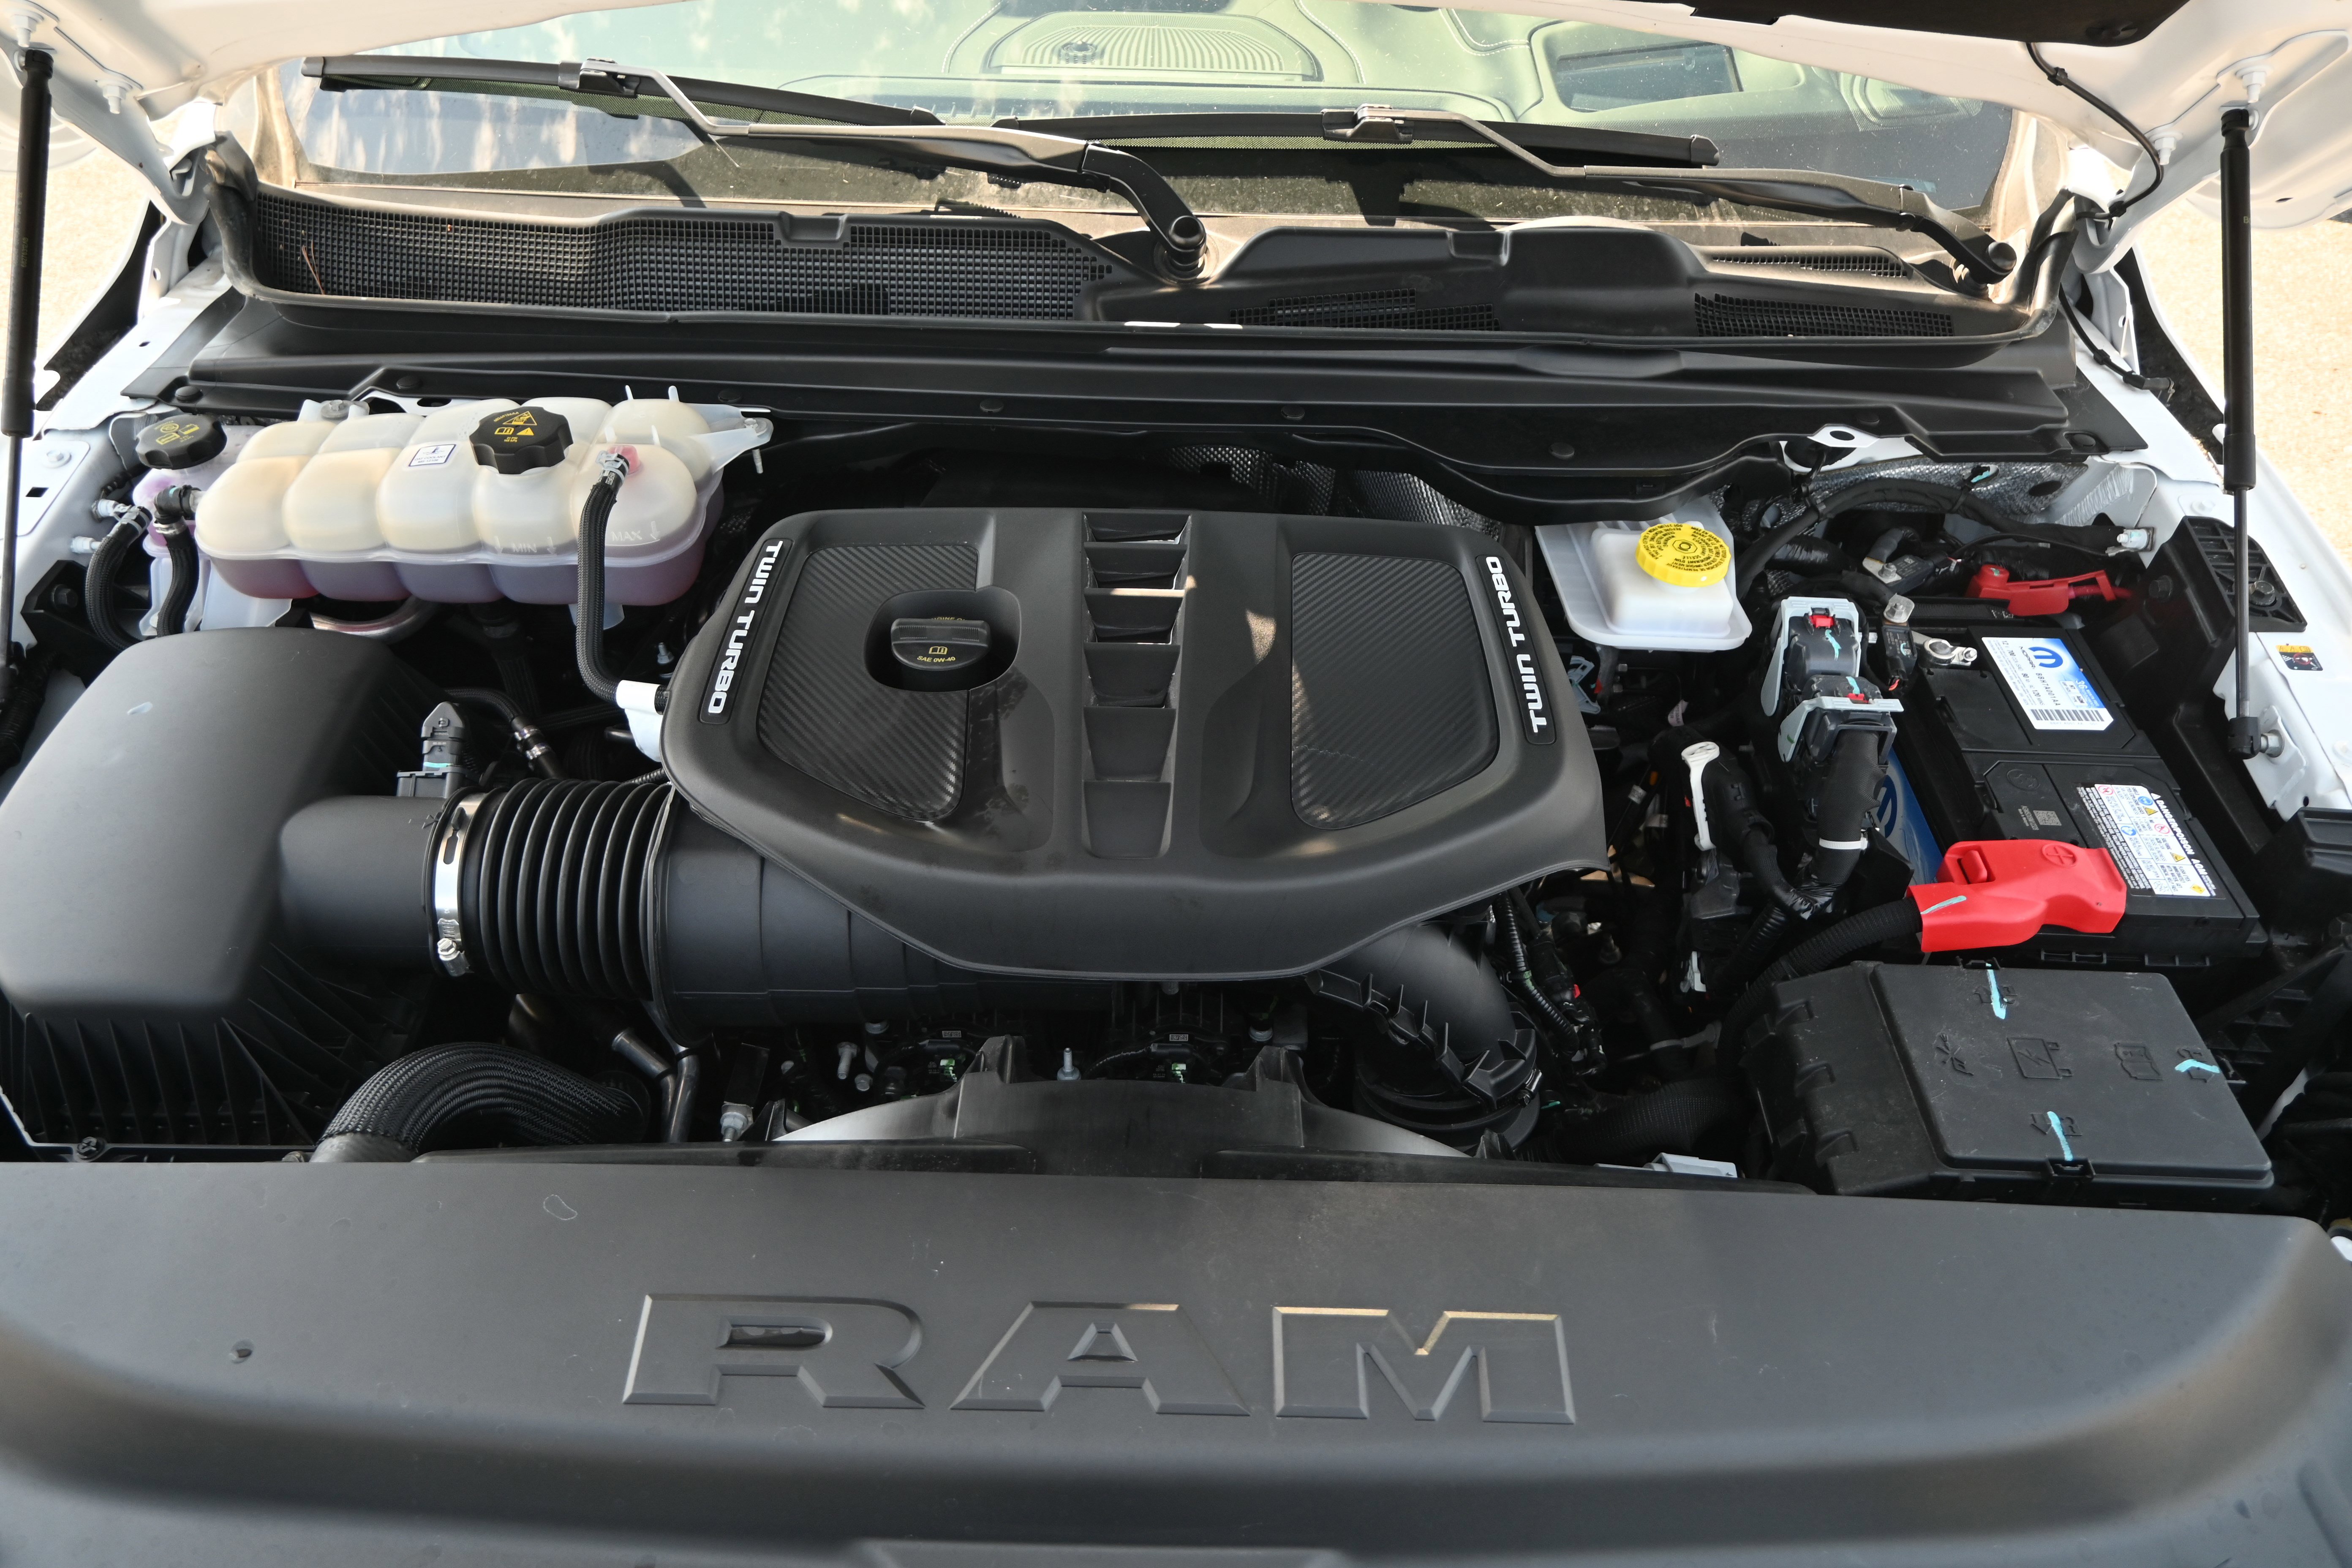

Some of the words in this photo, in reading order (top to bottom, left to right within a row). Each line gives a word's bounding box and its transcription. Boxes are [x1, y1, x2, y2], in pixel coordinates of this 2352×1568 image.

[513, 543, 537, 553] MIN
[612, 530, 642, 541] MAX
[745, 540, 783, 604] TWIN
[1486, 556, 1525, 647] TURBO
[708, 610, 755, 713] TURBO
[2019, 646, 2036, 668] MOPAR
[1516, 654, 1547, 733] TWIN
[2036, 672, 2061, 706] BBH7A001AA
[2075, 678, 2088, 689] 36
[2076, 695, 2085, 704] AGM
[2156, 800, 2195, 855] DANGER/POISON
[2191, 858, 2208, 876] AGM
[621, 1294, 1577, 1424] RAM
